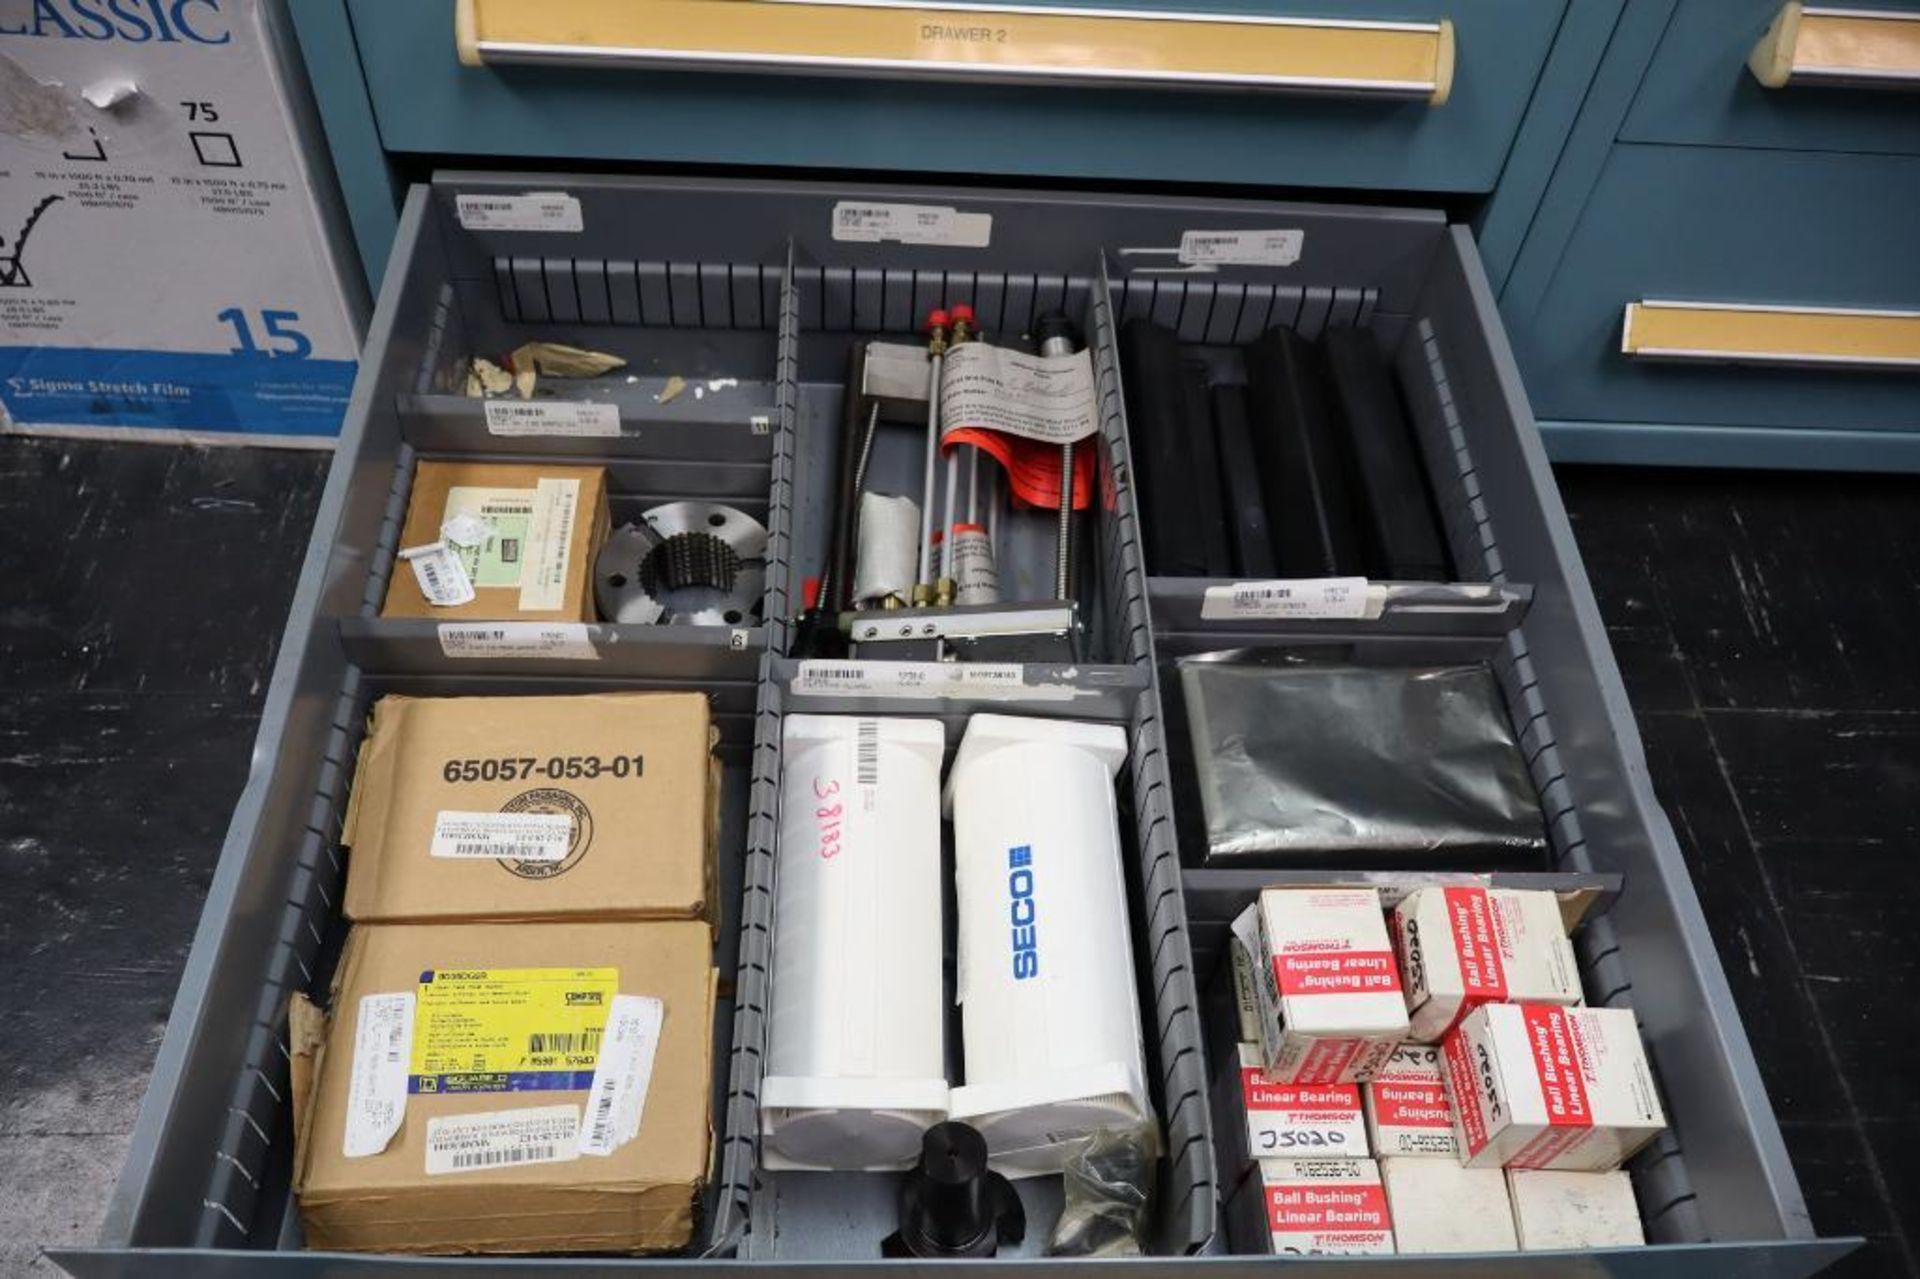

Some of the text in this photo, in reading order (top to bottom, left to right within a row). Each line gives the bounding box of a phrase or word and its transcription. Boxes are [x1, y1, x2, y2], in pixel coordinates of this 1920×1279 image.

[921, 25, 1008, 43] DRAWER 2
[181, 102, 219, 122] 75
[218, 308, 312, 359] 15
[30, 378, 190, 396] Sigma Stretch Film
[443, 754, 645, 783] 65057-053-01
[1009, 868, 1038, 981] SECO
[1470, 894, 1500, 988] Linear Bearing
[1286, 958, 1387, 972] Linear Bearing
[1365, 975, 1391, 986] Ball
[1465, 961, 1482, 988] Ball
[1549, 1012, 1583, 1115] Linear Bearing
[1252, 1091, 1351, 1105] Linear Bearing
[1382, 1087, 1434, 1103] Bearing
[1546, 1086, 1565, 1115] Ball
[1300, 1112, 1355, 1121] THOMSON
[1273, 1192, 1300, 1204] Ball
[1276, 1209, 1380, 1224] Linear Bearing
[1325, 1233, 1385, 1242] THOMSON
